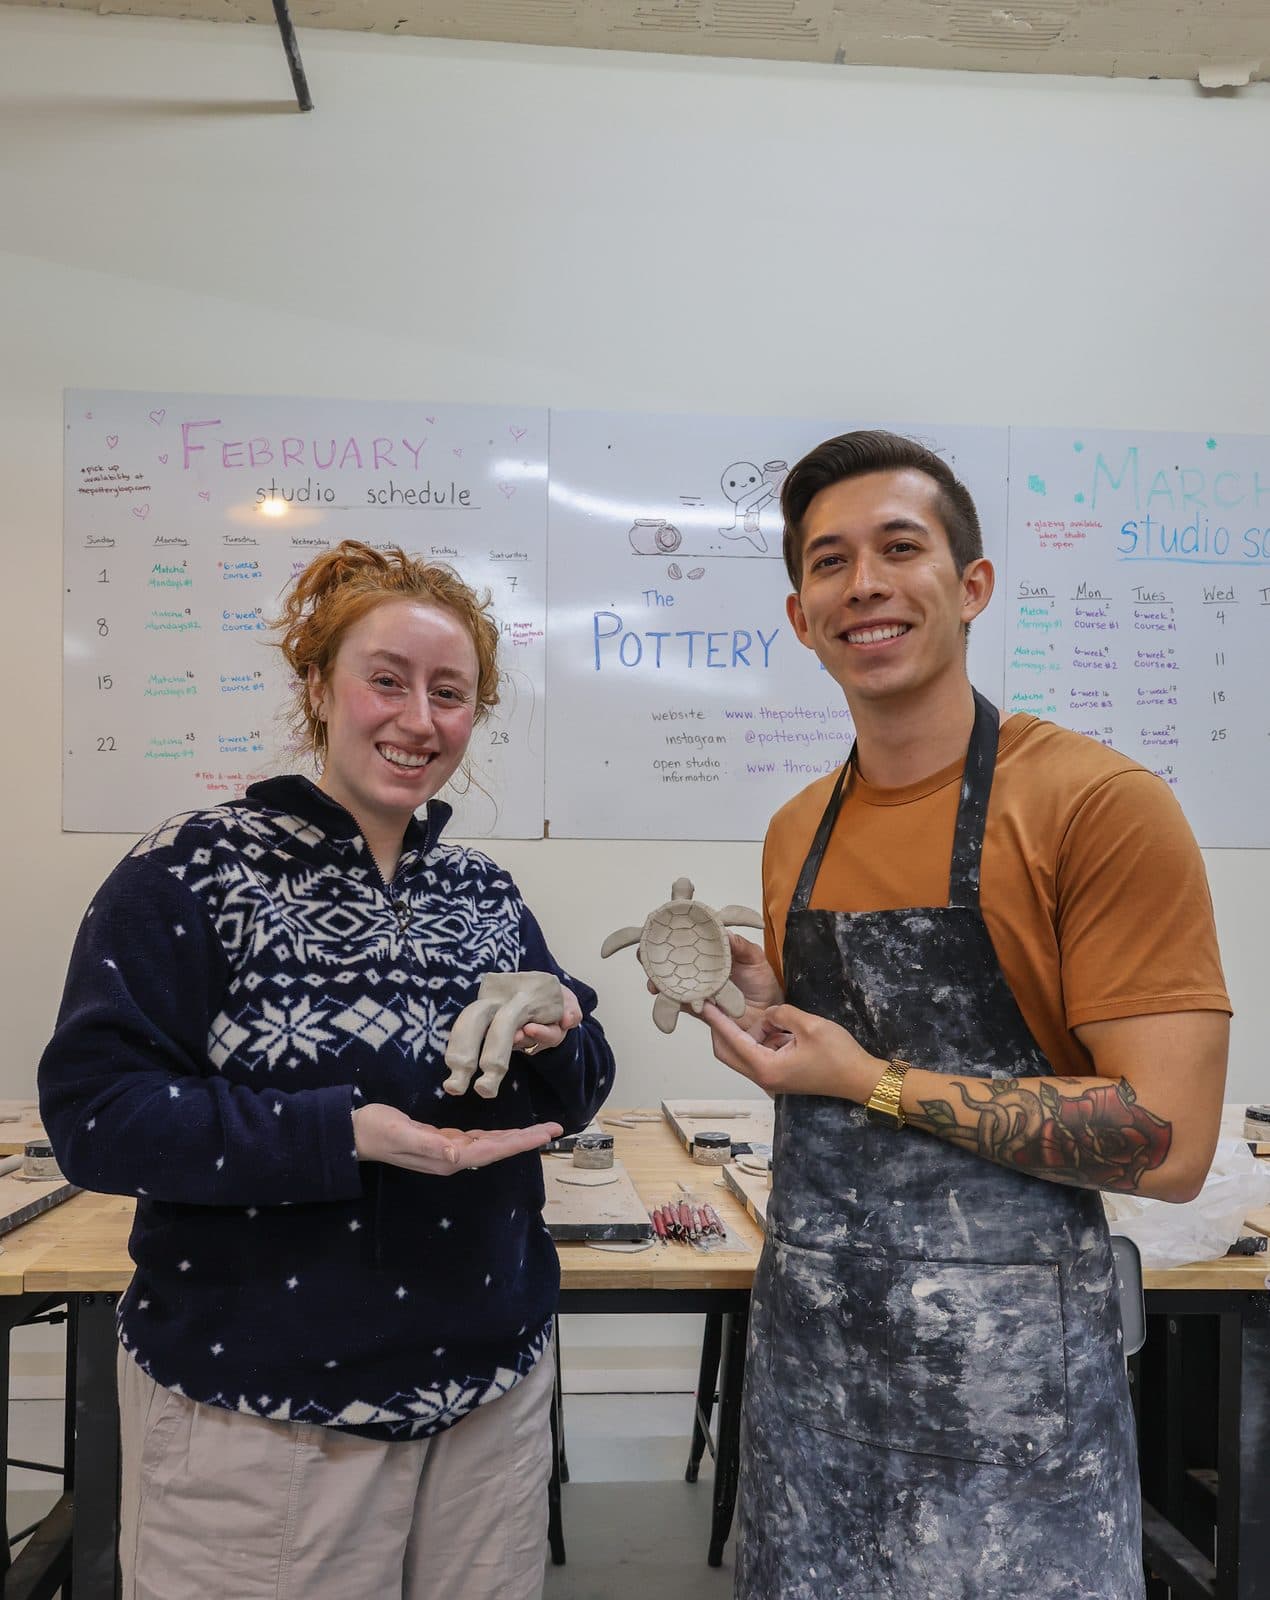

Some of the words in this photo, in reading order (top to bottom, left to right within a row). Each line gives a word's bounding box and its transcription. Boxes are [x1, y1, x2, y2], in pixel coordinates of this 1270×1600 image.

[181, 419, 428, 471] FEBRUARY
[255, 477, 335, 504] studio
[367, 480, 470, 506] schedule
[1117, 512, 1229, 554] studio
[86, 535, 115, 547] Sunday
[155, 536, 188, 546] Monday
[223, 535, 257, 545] Tuesday
[431, 546, 458, 557] Friday
[489, 550, 528, 560] Saturday
[507, 577, 518, 592] 7
[1019, 582, 1048, 596] Sun
[1076, 581, 1102, 600] Mon
[642, 589, 674, 608] The
[1132, 586, 1166, 601] Tues
[1203, 585, 1235, 600] Wed
[1075, 607, 1107, 617] 6-week
[1134, 610, 1168, 620] 6-week
[1216, 611, 1225, 624] 4
[97, 618, 109, 637] 8
[222, 624, 253, 632] course
[1074, 620, 1107, 630] course
[1134, 622, 1166, 631] course
[593, 611, 780, 671] POTTERY
[1074, 646, 1106, 657] 6-week
[1137, 649, 1166, 659] 6-week
[1073, 660, 1103, 669] course
[1215, 652, 1225, 666] 11
[97, 675, 113, 690] 15
[1070, 688, 1100, 697] 6-week
[1137, 688, 1169, 696] 6-week
[1212, 690, 1226, 704] 18
[1069, 700, 1099, 708] course
[651, 709, 705, 721] website
[490, 731, 510, 745] 28
[666, 729, 727, 750] instagram
[744, 727, 856, 748] @potterychicag
[1211, 729, 1227, 741] 25
[97, 736, 117, 752] 22
[219, 745, 249, 753] course
[653, 758, 681, 770] open
[686, 757, 721, 768] studio
[662, 771, 720, 784] information
